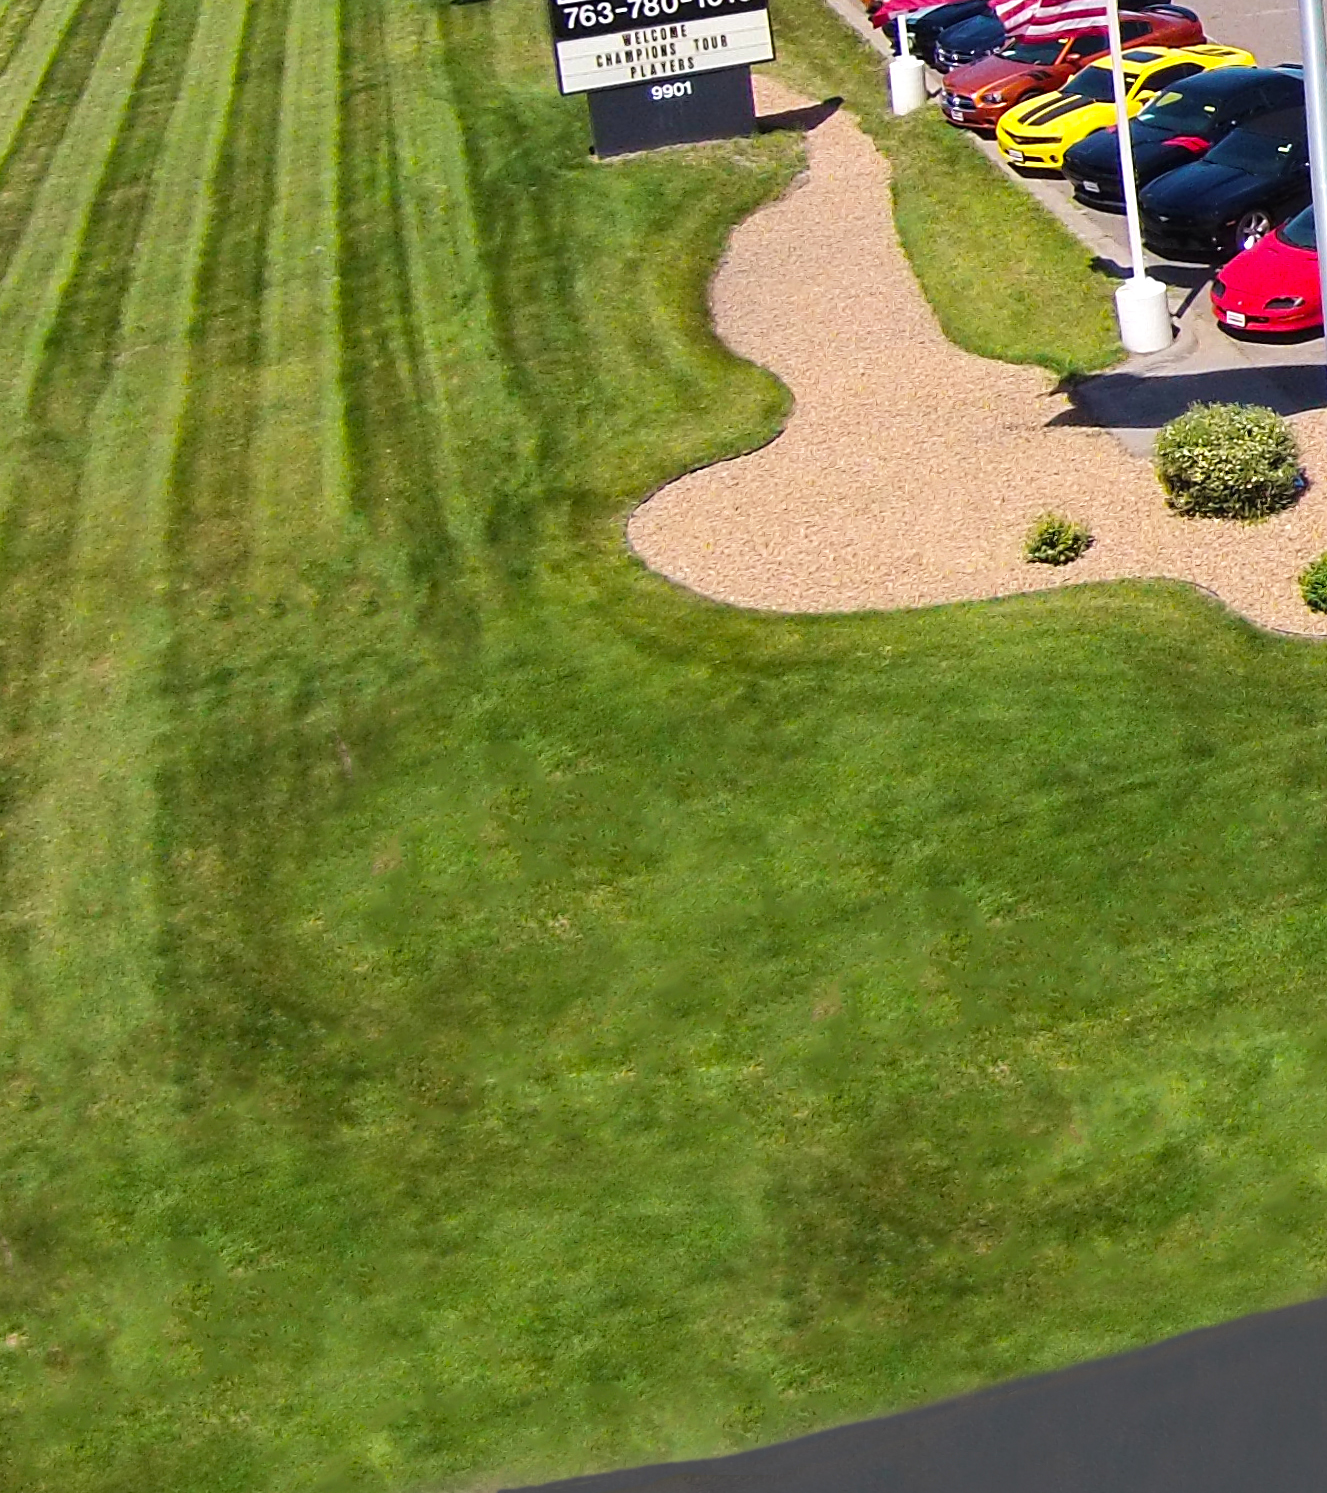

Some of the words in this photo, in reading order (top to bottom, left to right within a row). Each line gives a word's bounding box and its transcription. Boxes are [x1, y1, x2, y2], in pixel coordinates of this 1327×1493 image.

[622, 24, 688, 46] WELCOME
[596, 43, 676, 68] CHAMPIONS
[693, 34, 728, 52] TOUR
[630, 57, 695, 79] PLAYERS
[651, 80, 693, 100] 9901
